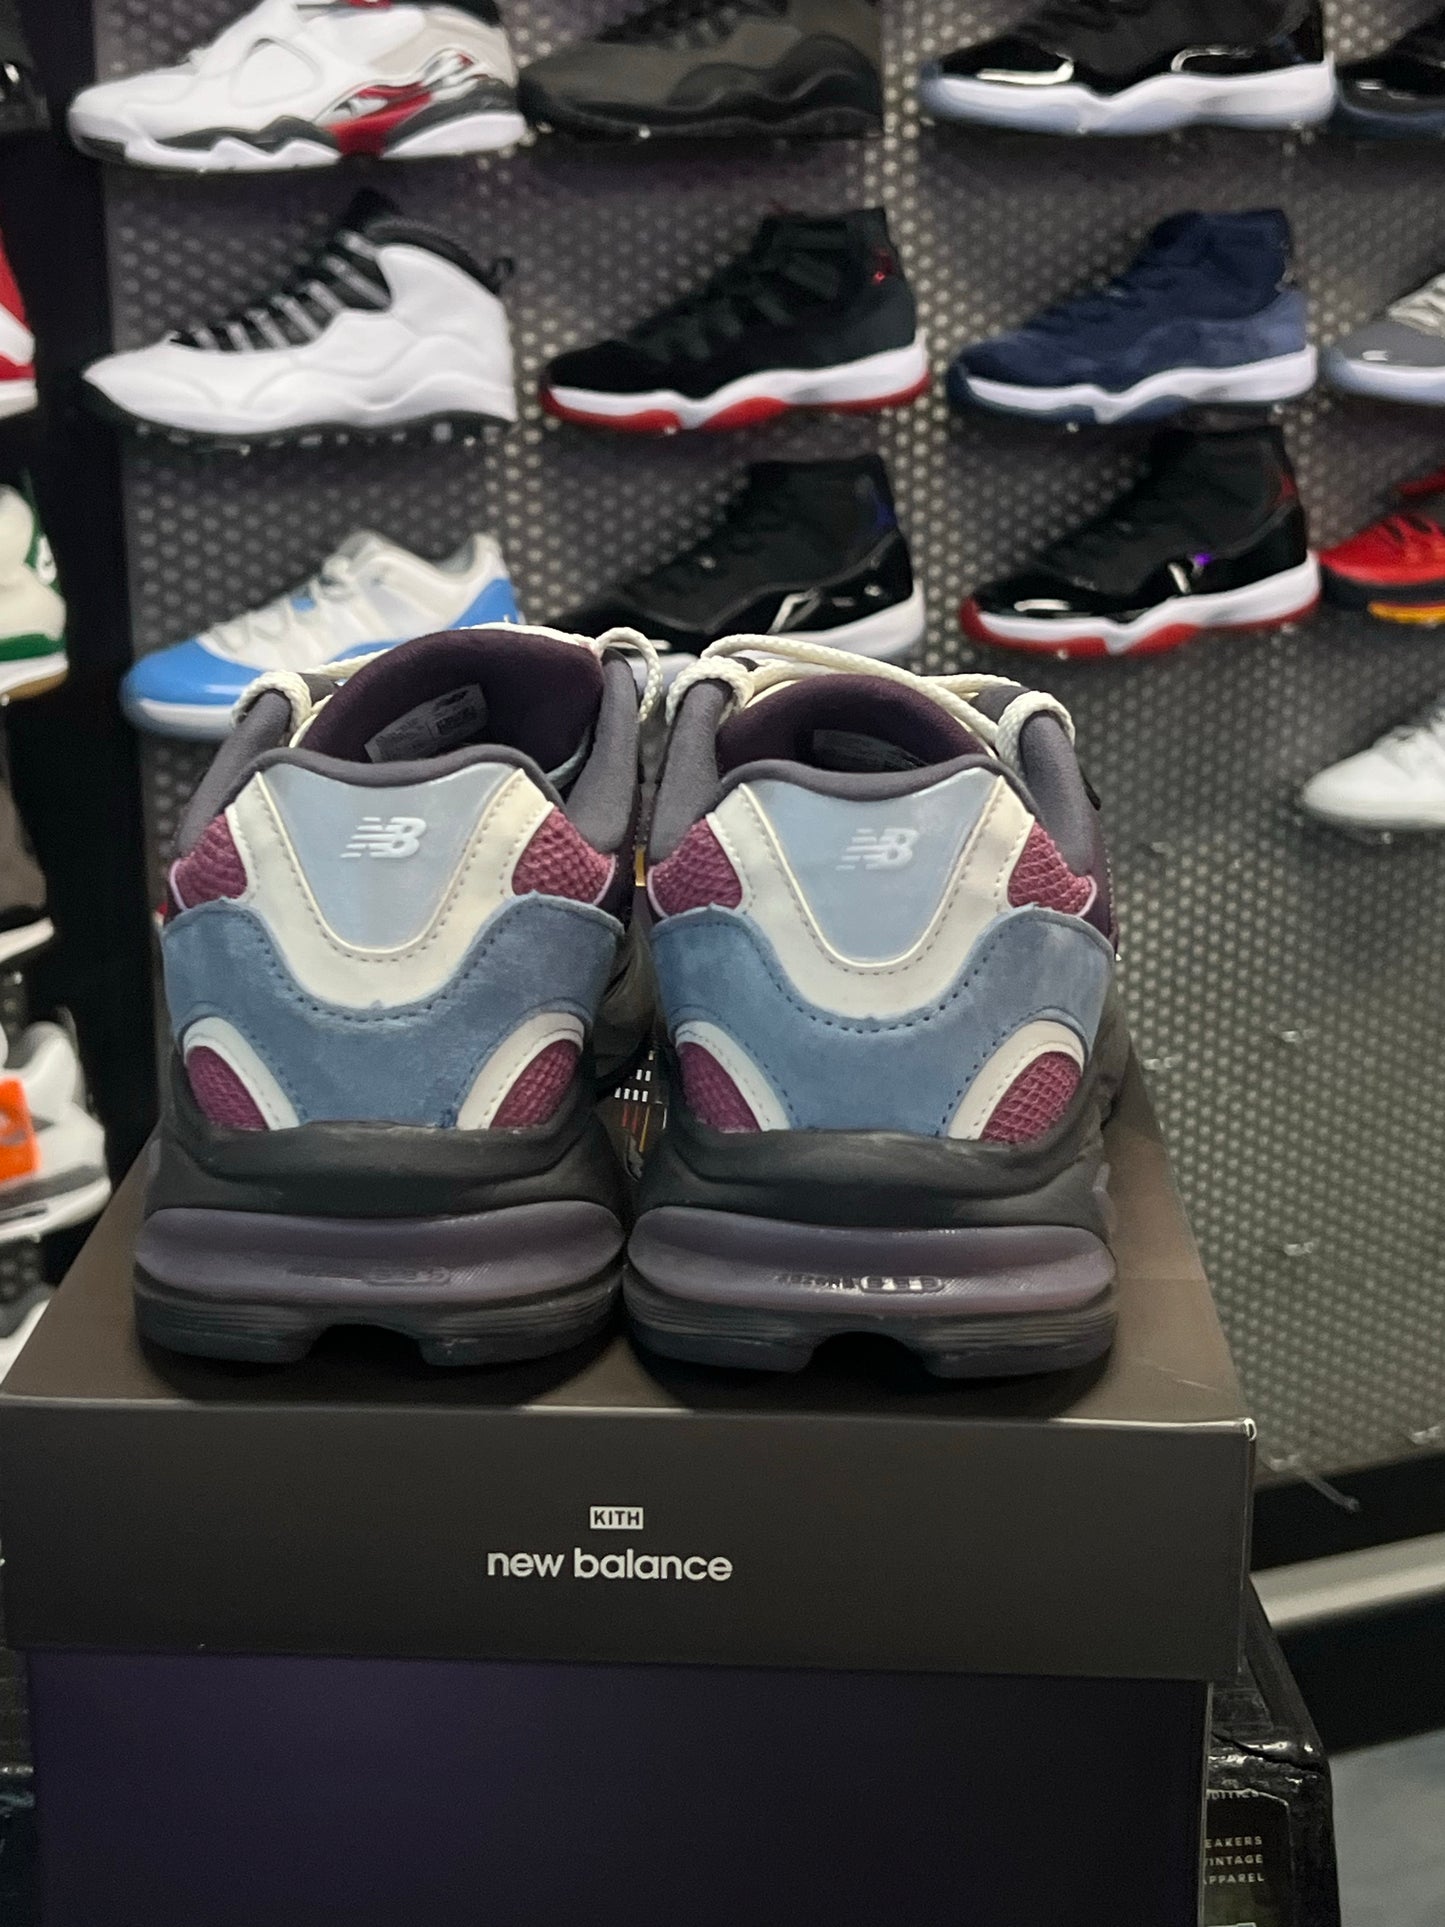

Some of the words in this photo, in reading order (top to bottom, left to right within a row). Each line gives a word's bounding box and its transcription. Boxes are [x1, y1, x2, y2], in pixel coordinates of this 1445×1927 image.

[340, 816, 427, 858] NB
[835, 828, 919, 871] NB
[593, 1510, 641, 1527] KITH
[487, 1552, 565, 1577] new
[573, 1547, 733, 1581] balance
